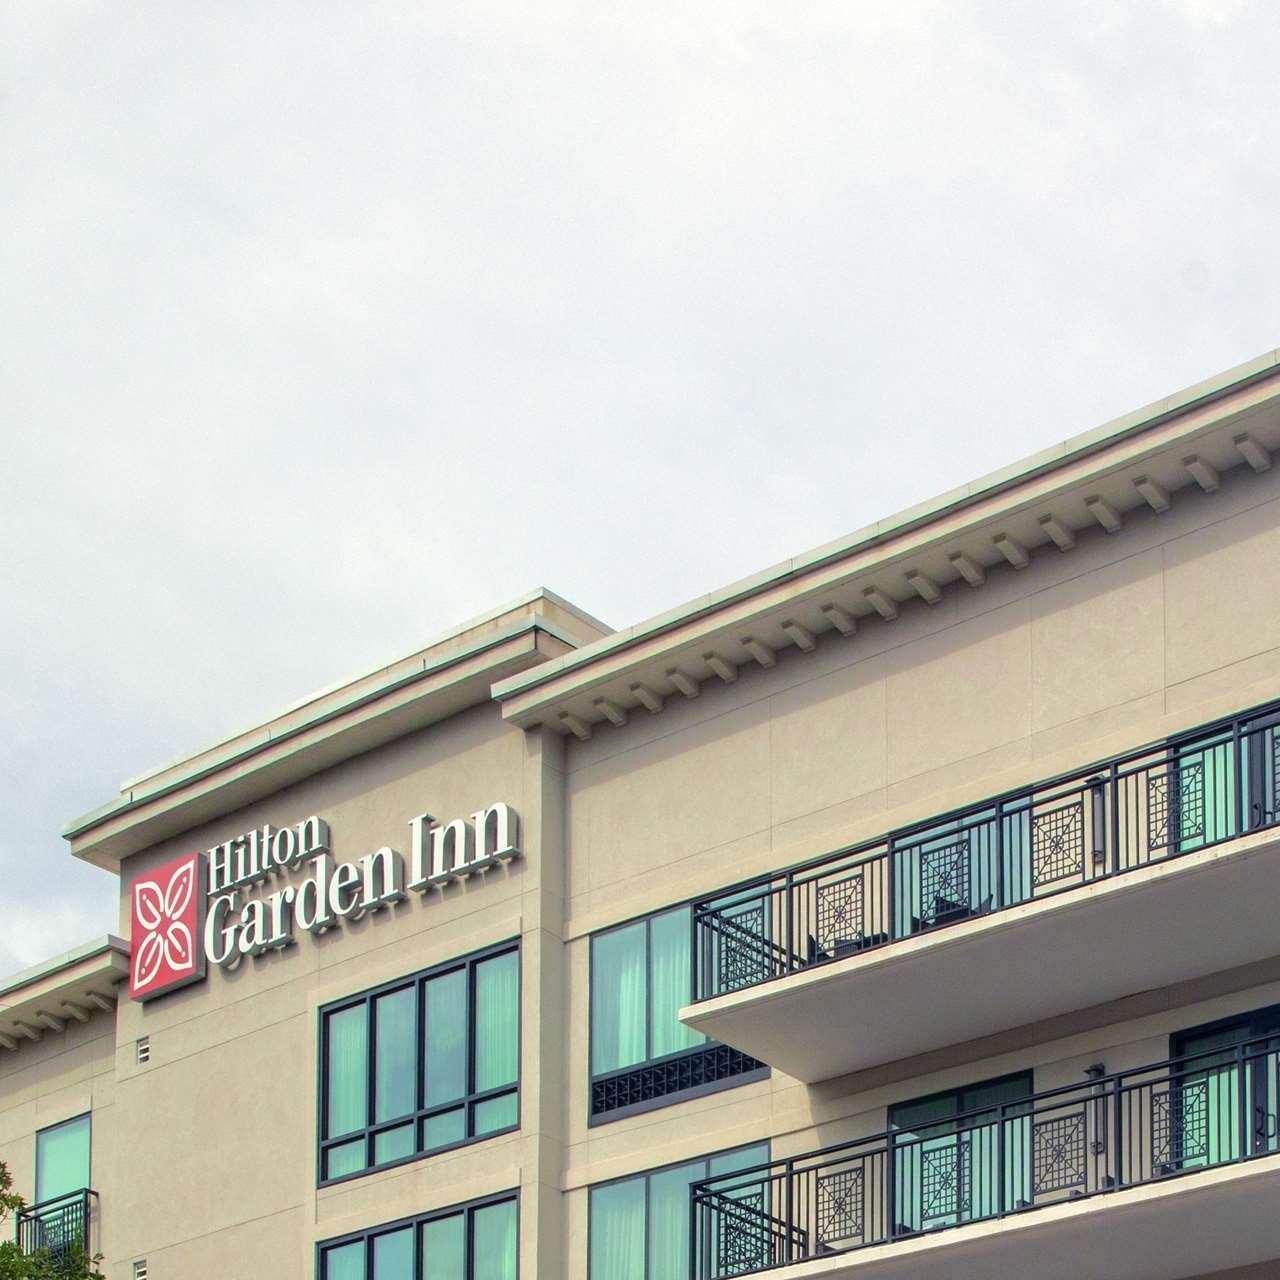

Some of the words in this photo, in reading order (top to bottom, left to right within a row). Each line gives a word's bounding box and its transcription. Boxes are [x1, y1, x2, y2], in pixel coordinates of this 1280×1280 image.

[204, 846, 404, 965] Garden
[407, 802, 519, 890] Inn
[207, 814, 329, 896] Hilton
